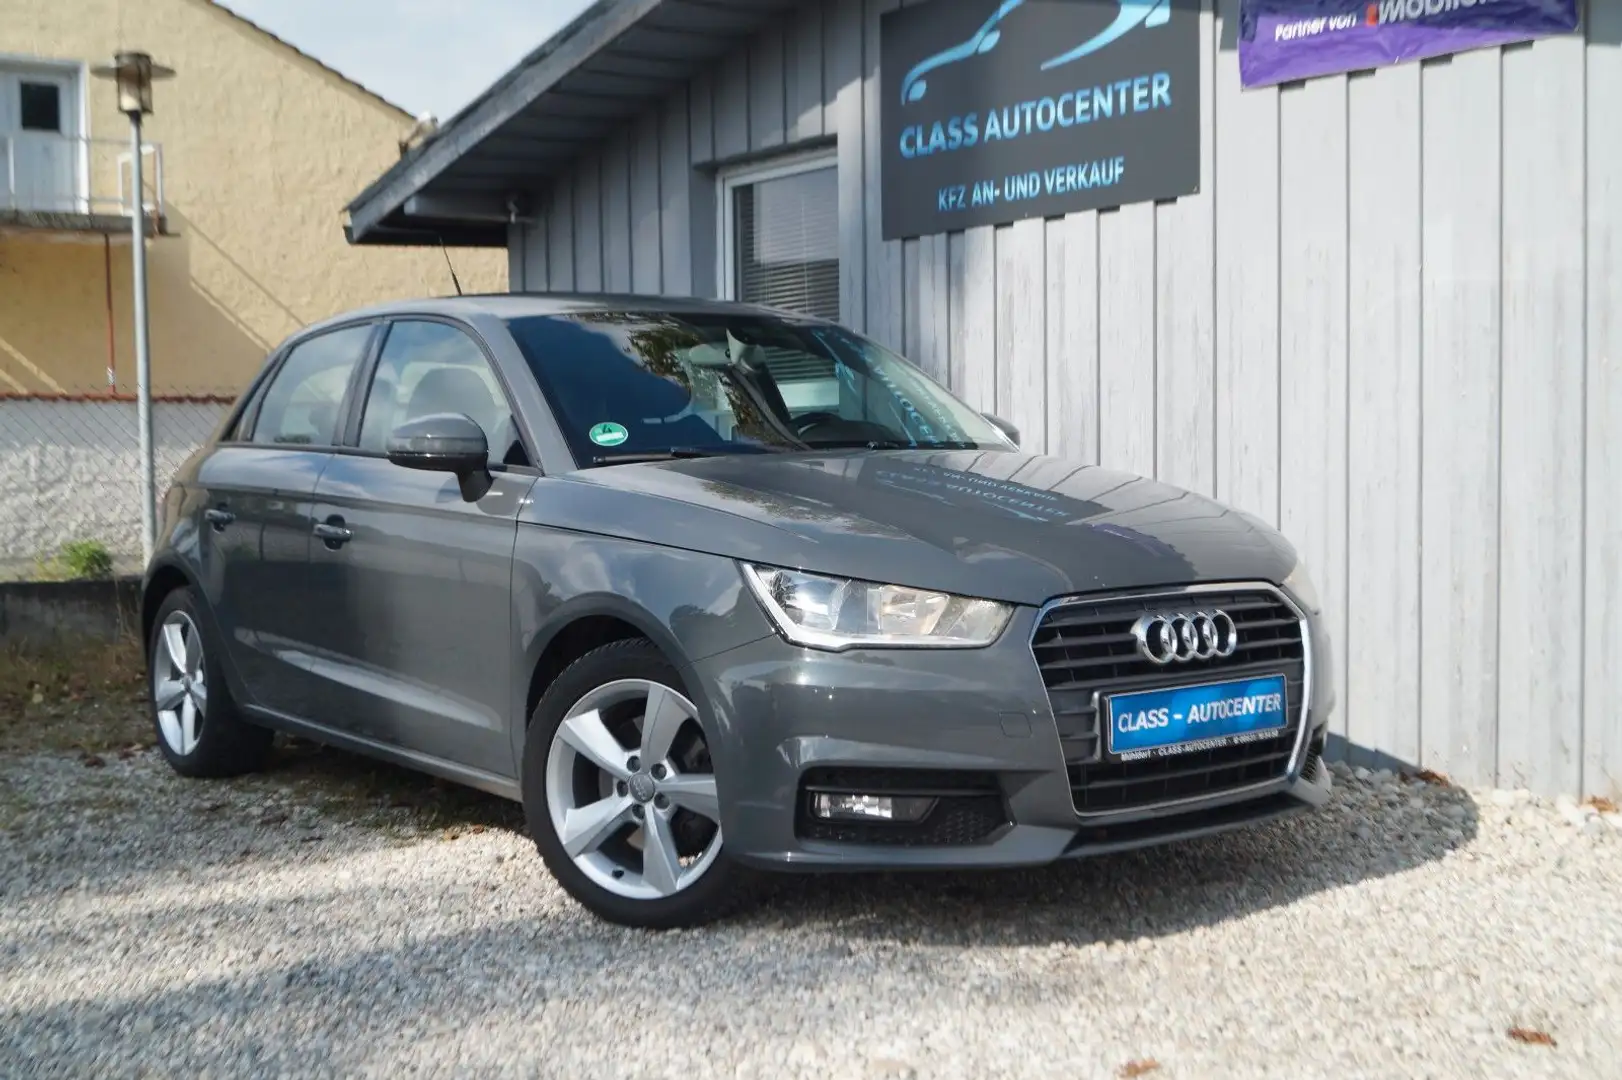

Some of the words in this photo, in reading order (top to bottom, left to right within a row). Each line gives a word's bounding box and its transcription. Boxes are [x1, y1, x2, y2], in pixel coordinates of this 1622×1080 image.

[1275, 17, 1327, 41] Partner
[1329, 13, 1357, 31] von
[900, 112, 979, 159] CLASS
[984, 72, 1172, 143] AUTOCENTER
[938, 186, 966, 211] KFZ
[972, 180, 1001, 207] AN-
[1004, 172, 1041, 201] UND
[1044, 156, 1125, 194] VERKAUF
[1118, 707, 1169, 733] CLASS
[1187, 693, 1281, 724] AUTOCENTER
